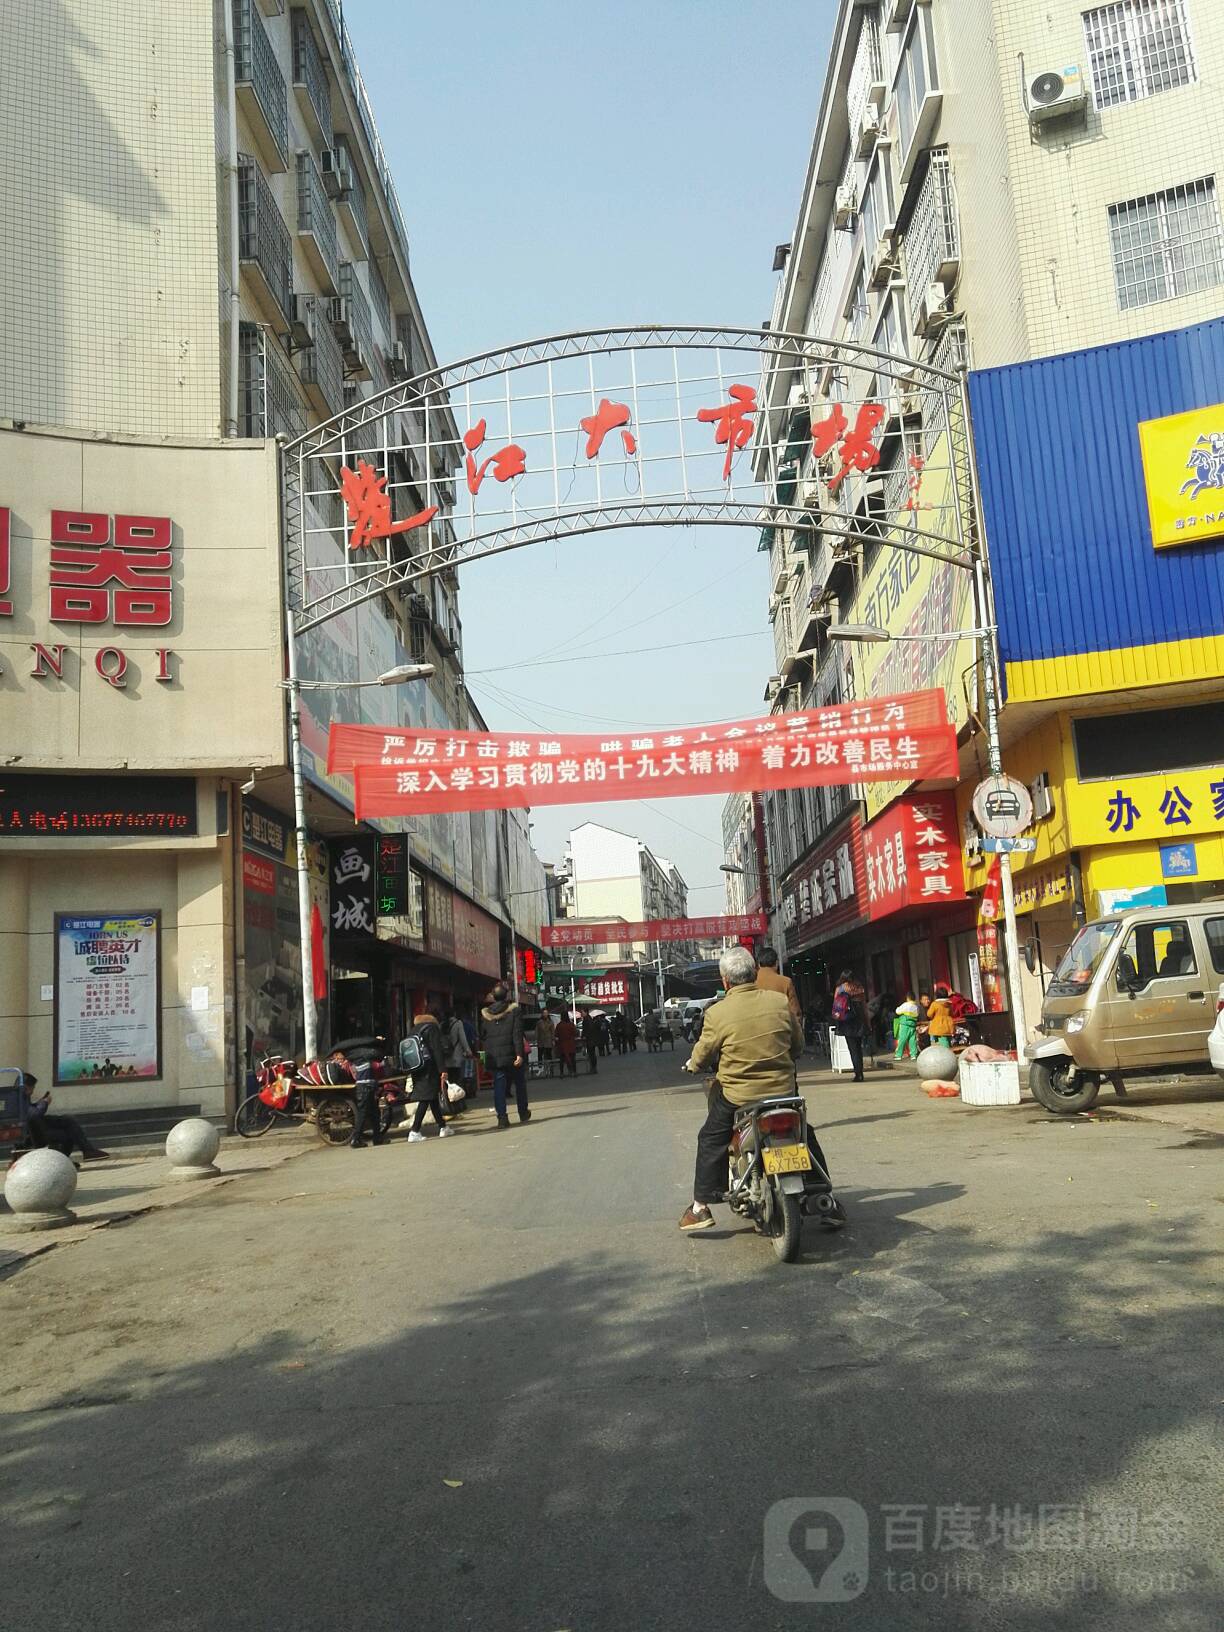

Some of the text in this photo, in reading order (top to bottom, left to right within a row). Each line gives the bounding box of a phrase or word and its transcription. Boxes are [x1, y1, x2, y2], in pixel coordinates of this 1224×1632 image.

[0, 507, 173, 627] 器
[0, 643, 173, 688] NQI
[382, 702, 905, 758] 严厉打击欺骗哄骗老人会议营销行为
[397, 734, 921, 794] 深入学习贯彻党的十九大精神 着力改善民生
[866, 831, 907, 903] 实木家具
[912, 803, 952, 896] 实木家具
[332, 848, 374, 934] 画城
[75, 938, 142, 955] 诚聘英才
